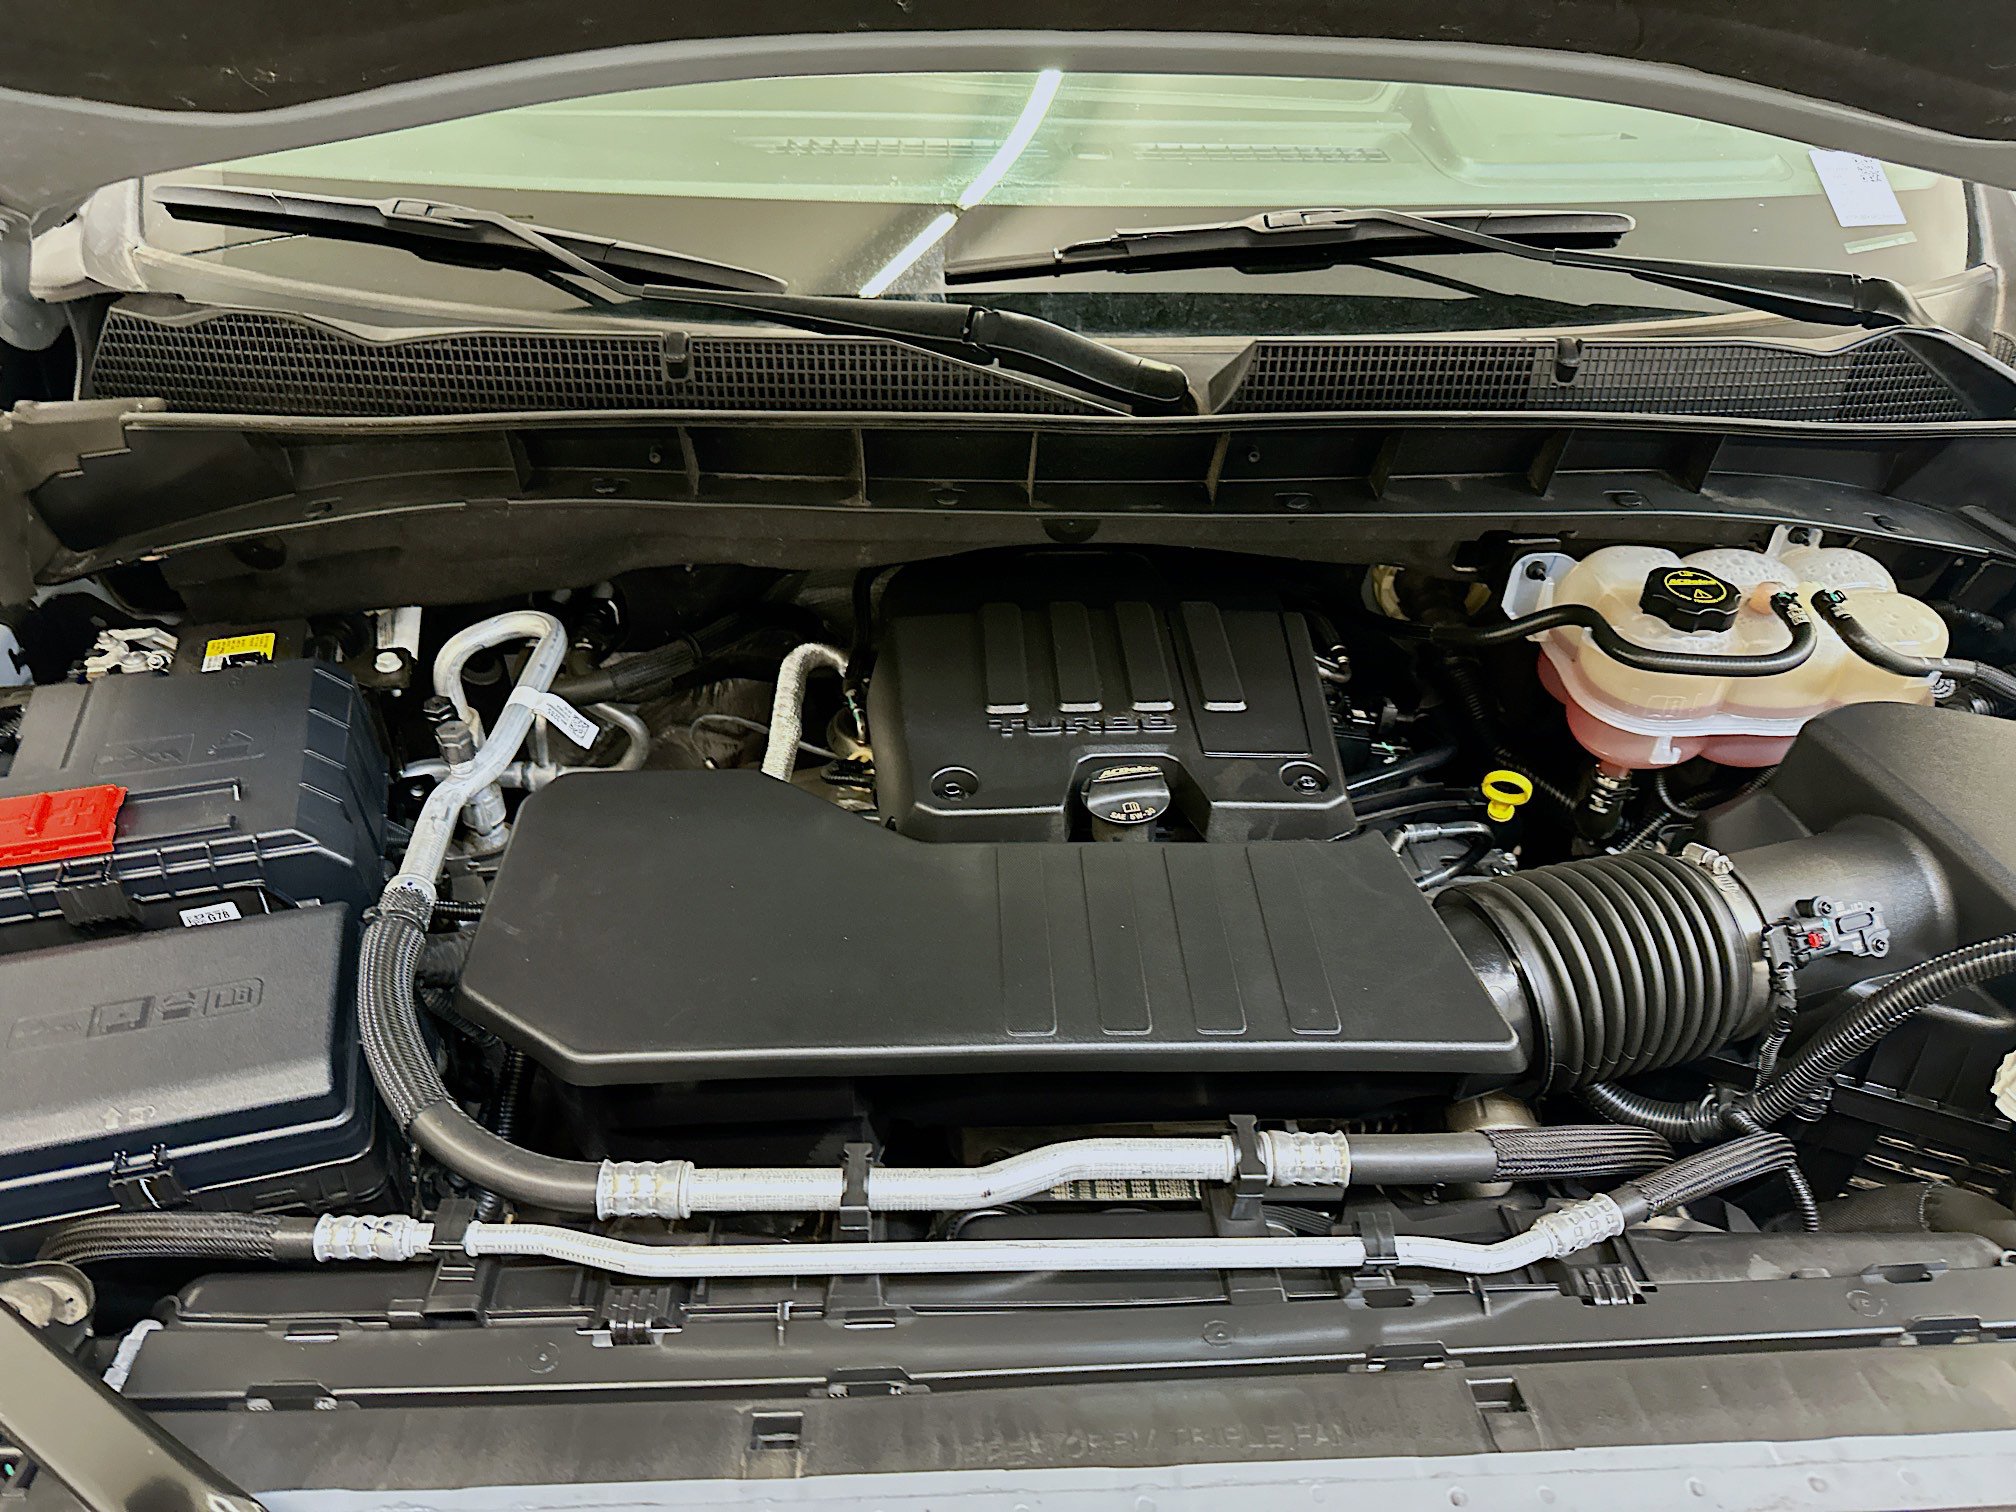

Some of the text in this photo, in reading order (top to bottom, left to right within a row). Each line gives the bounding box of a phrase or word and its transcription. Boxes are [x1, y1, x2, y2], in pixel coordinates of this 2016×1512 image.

[988, 716, 1178, 737] TURBO
[1099, 765, 1159, 779] ACDelco
[1110, 811, 1127, 820] SAE
